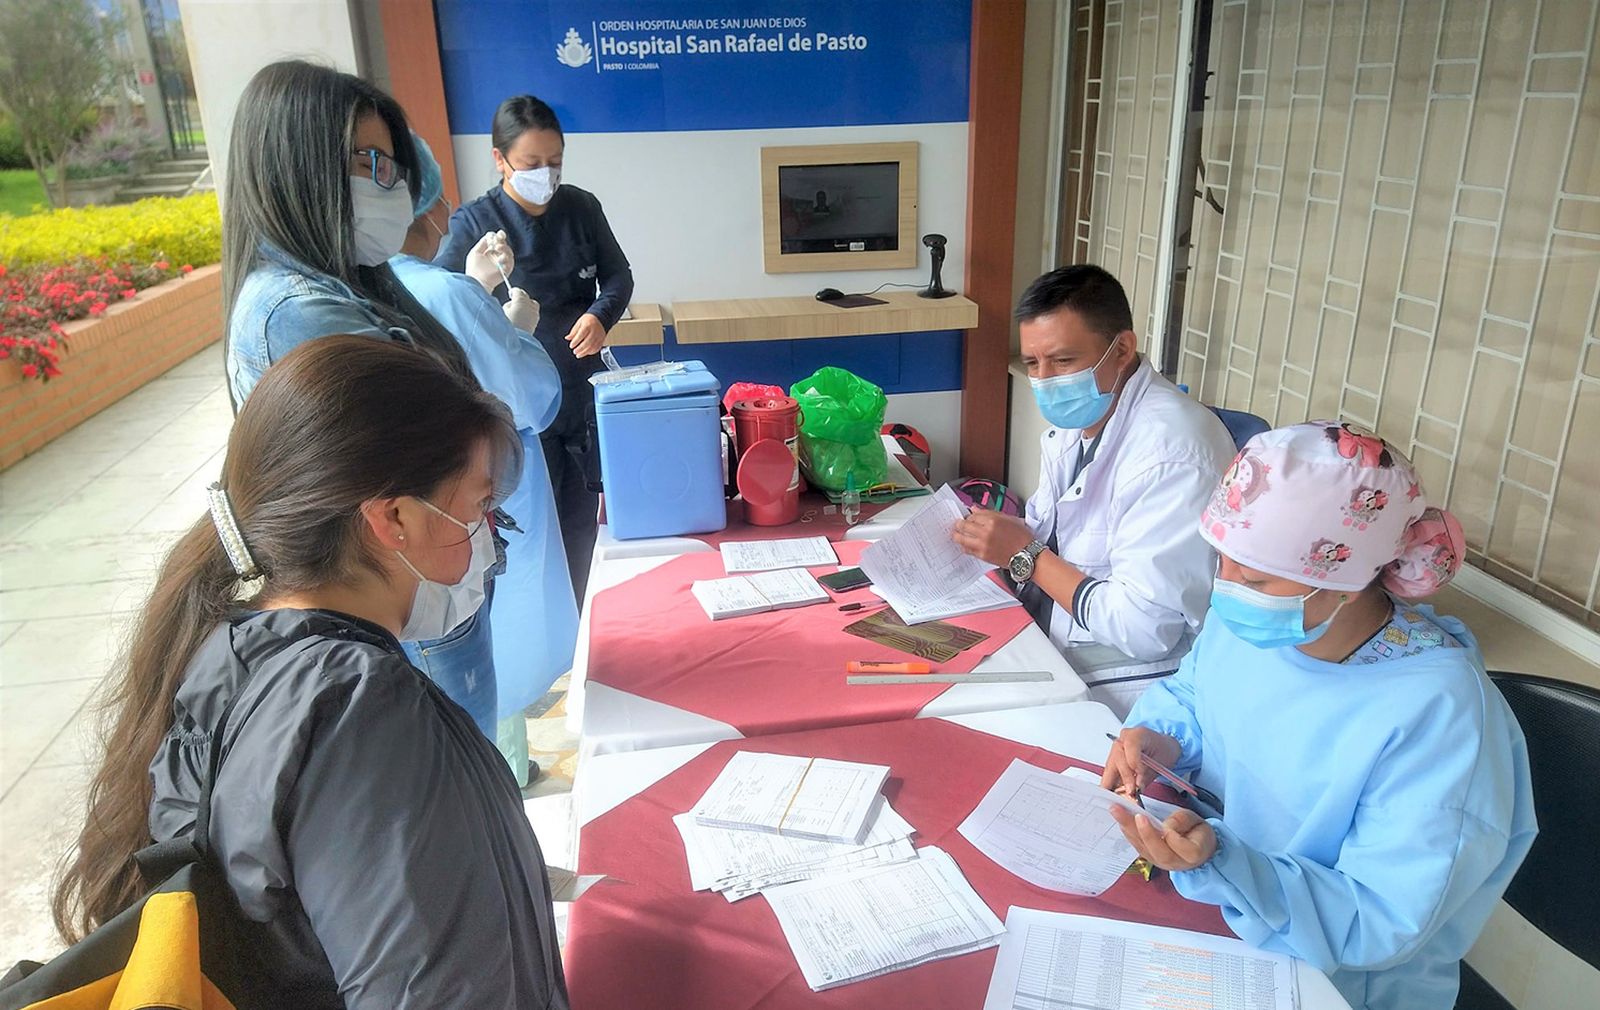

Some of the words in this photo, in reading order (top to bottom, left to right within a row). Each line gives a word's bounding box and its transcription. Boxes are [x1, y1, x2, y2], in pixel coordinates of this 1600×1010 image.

[599, 21, 634, 31] ORDEN
[635, 20, 704, 31] HOSPITALARIA
[706, 19, 719, 29] DE
[720, 19, 740, 29] SAN
[742, 18, 767, 29] JUAN
[768, 18, 782, 28] DE
[783, 17, 807, 28] DIOS
[601, 35, 682, 59] Hospital
[686, 35, 722, 53] San
[725, 33, 784, 52] Rafael
[788, 32, 812, 52] de
[816, 33, 867, 51] Pasto
